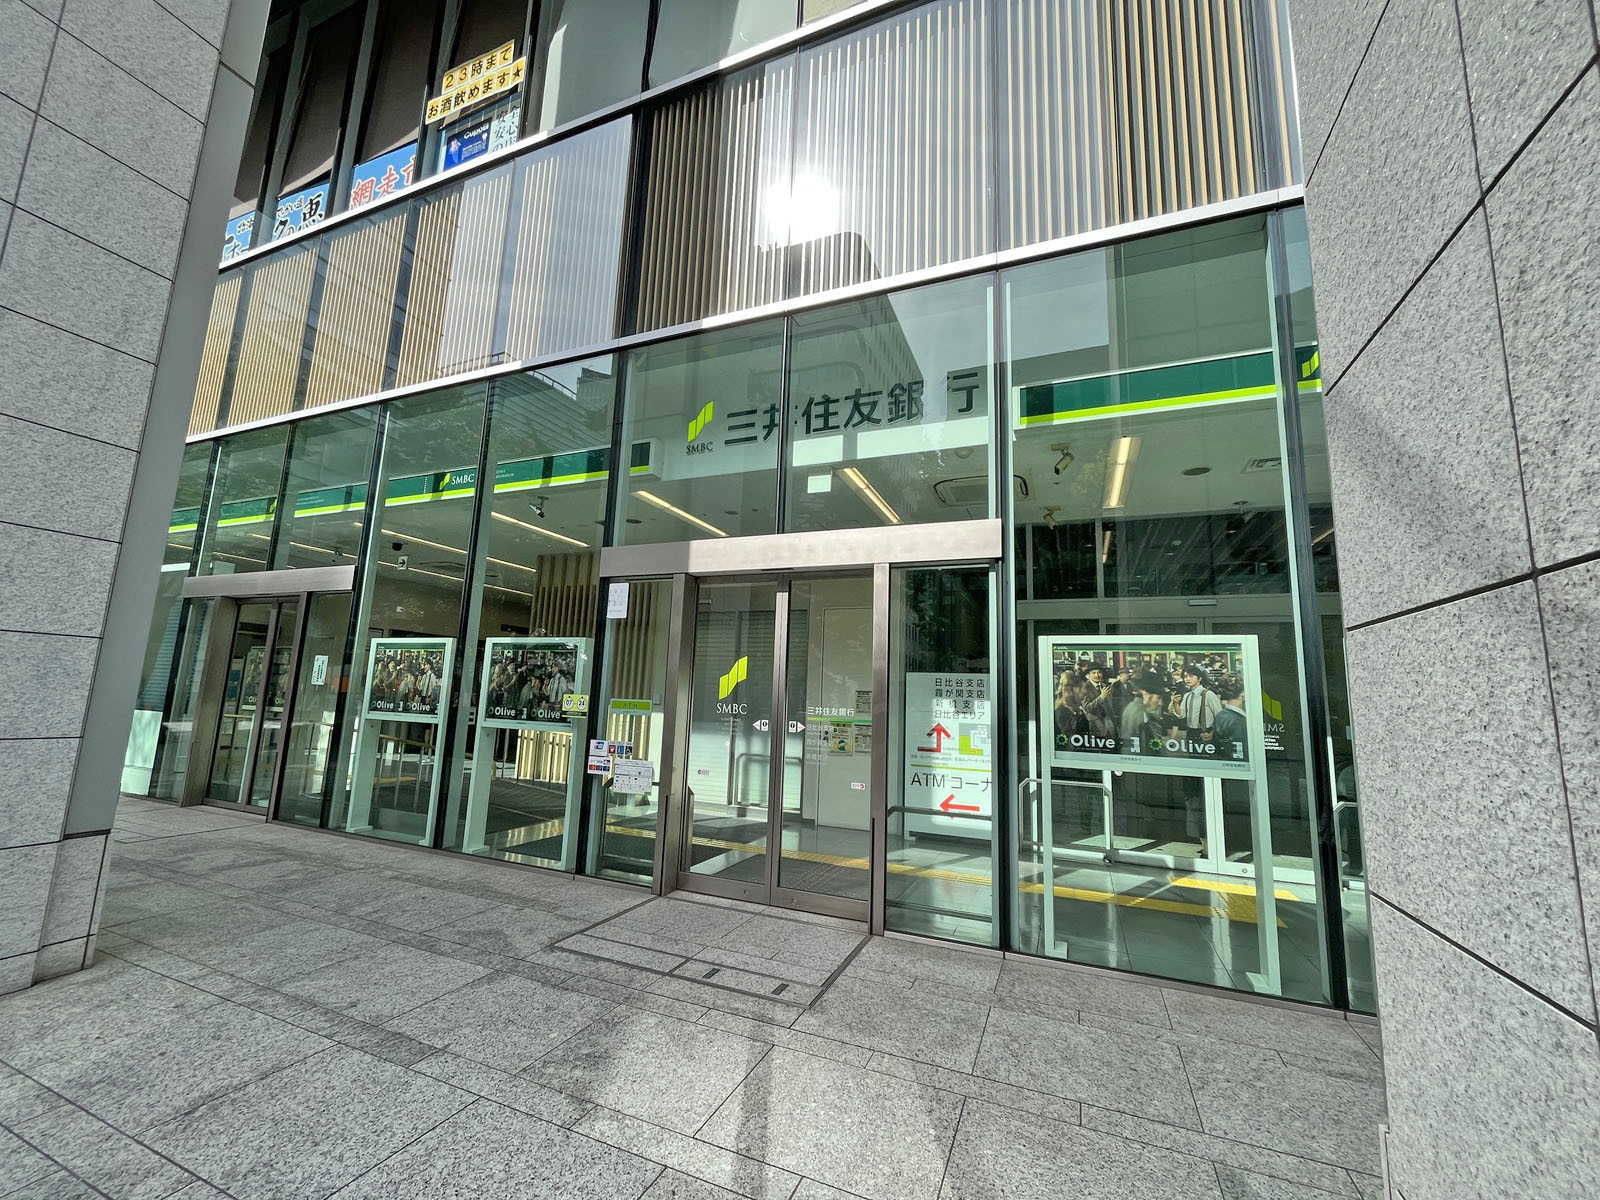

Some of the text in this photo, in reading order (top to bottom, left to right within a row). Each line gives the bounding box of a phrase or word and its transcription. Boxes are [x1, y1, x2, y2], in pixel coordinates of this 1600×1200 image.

[445, 46, 512, 90] 23時まで
[686, 441, 714, 455] SMBC
[451, 473, 475, 485] SMBC
[935, 677, 985, 688] 日比谷支店
[935, 688, 985, 699] 霞が関支店
[376, 700, 431, 712] Olive Olive
[716, 702, 748, 715] SMBC
[807, 706, 855, 717] 三井住友銀行
[494, 706, 561, 719] Olive Olive
[934, 709, 985, 720] 日比谷エリア
[1070, 733, 1216, 754] Olive Olive
